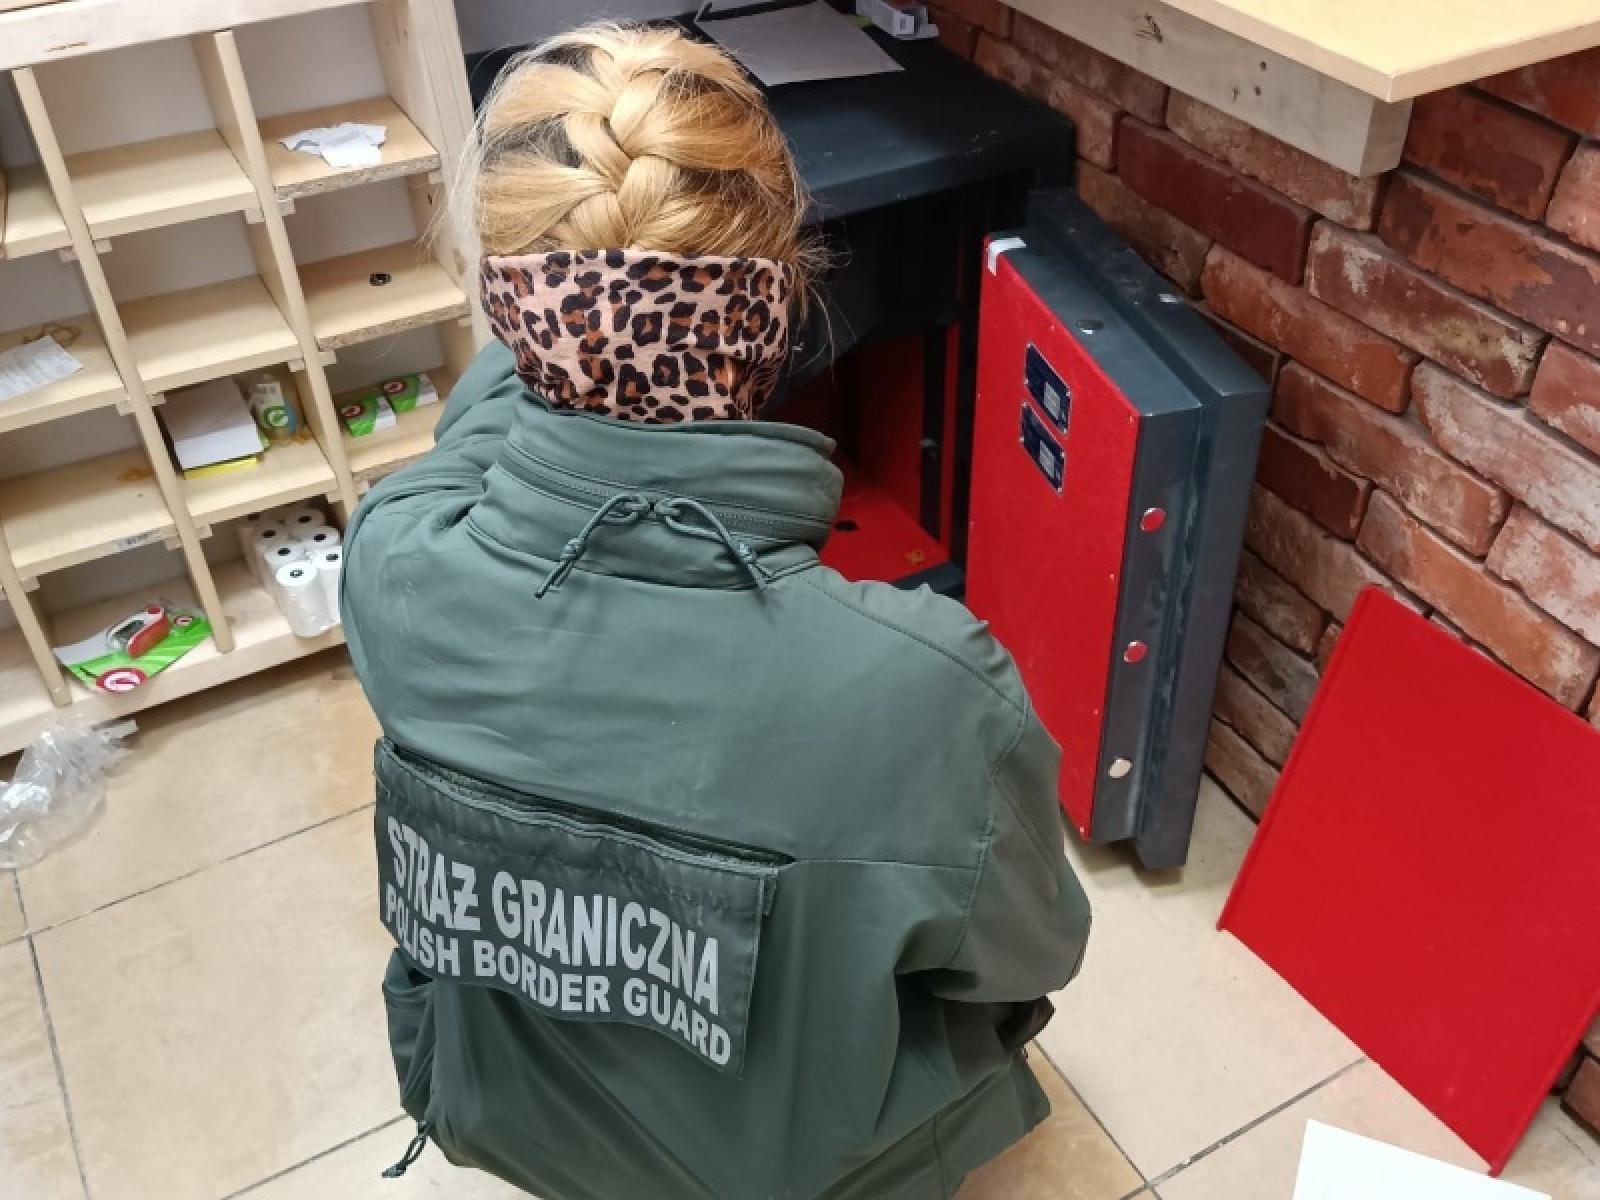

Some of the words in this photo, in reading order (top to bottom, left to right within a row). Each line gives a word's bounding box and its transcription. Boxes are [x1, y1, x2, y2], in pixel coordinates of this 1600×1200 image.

[385, 882, 461, 977] POLISH
[473, 939, 611, 1013] BORDER
[622, 977, 731, 1066] GUARD
[491, 871, 719, 1015] GRANICZNA
